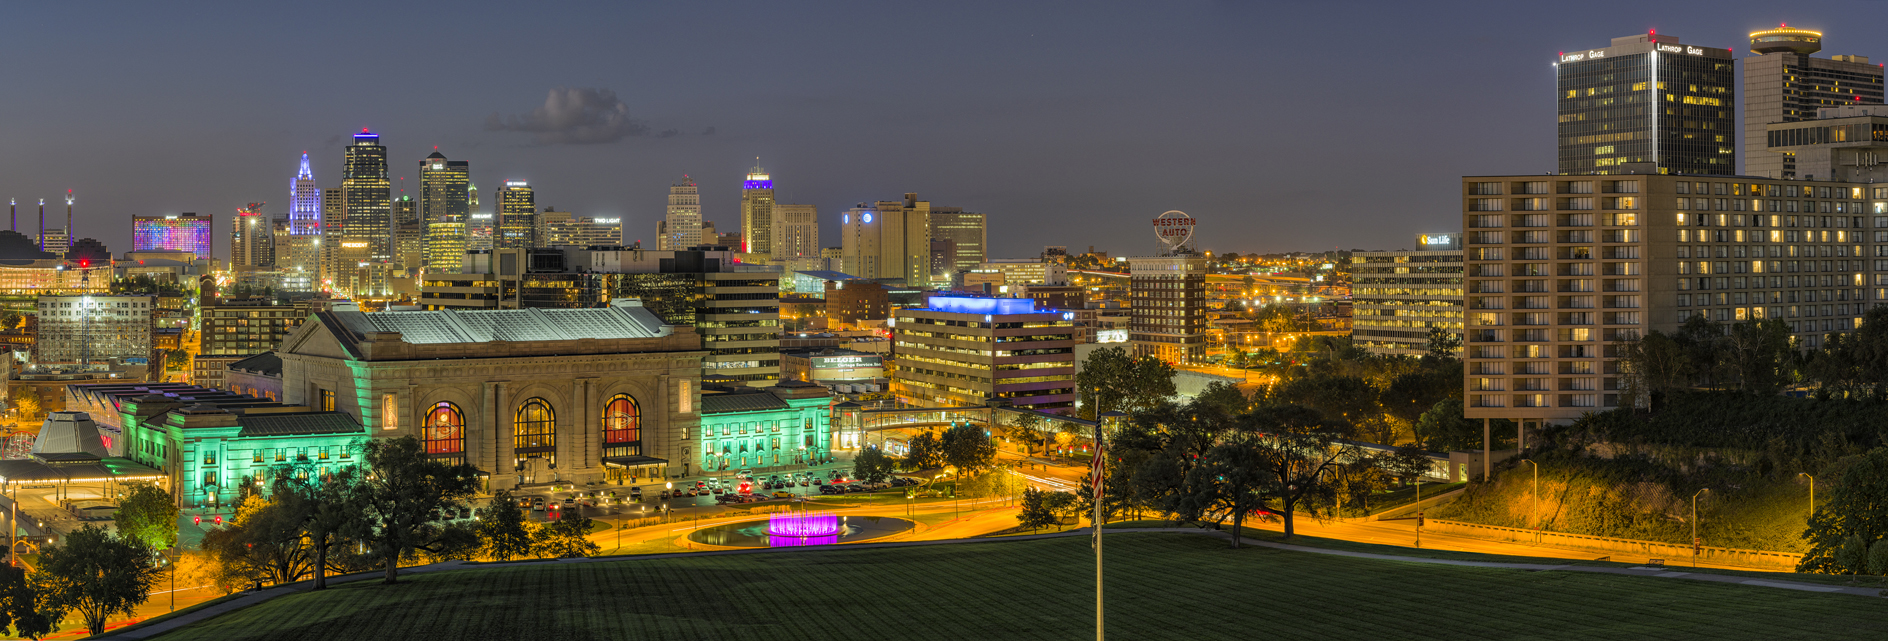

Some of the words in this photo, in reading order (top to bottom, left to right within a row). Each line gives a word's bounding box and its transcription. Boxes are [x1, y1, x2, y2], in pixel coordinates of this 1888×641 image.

[1657, 42, 1682, 53] LATHROP
[1687, 46, 1703, 56] GAGE
[1561, 54, 1584, 62] LATHROP
[1589, 50, 1604, 59] GAGE
[1152, 217, 1196, 227] WESTERN
[1162, 228, 1187, 237] AUTO
